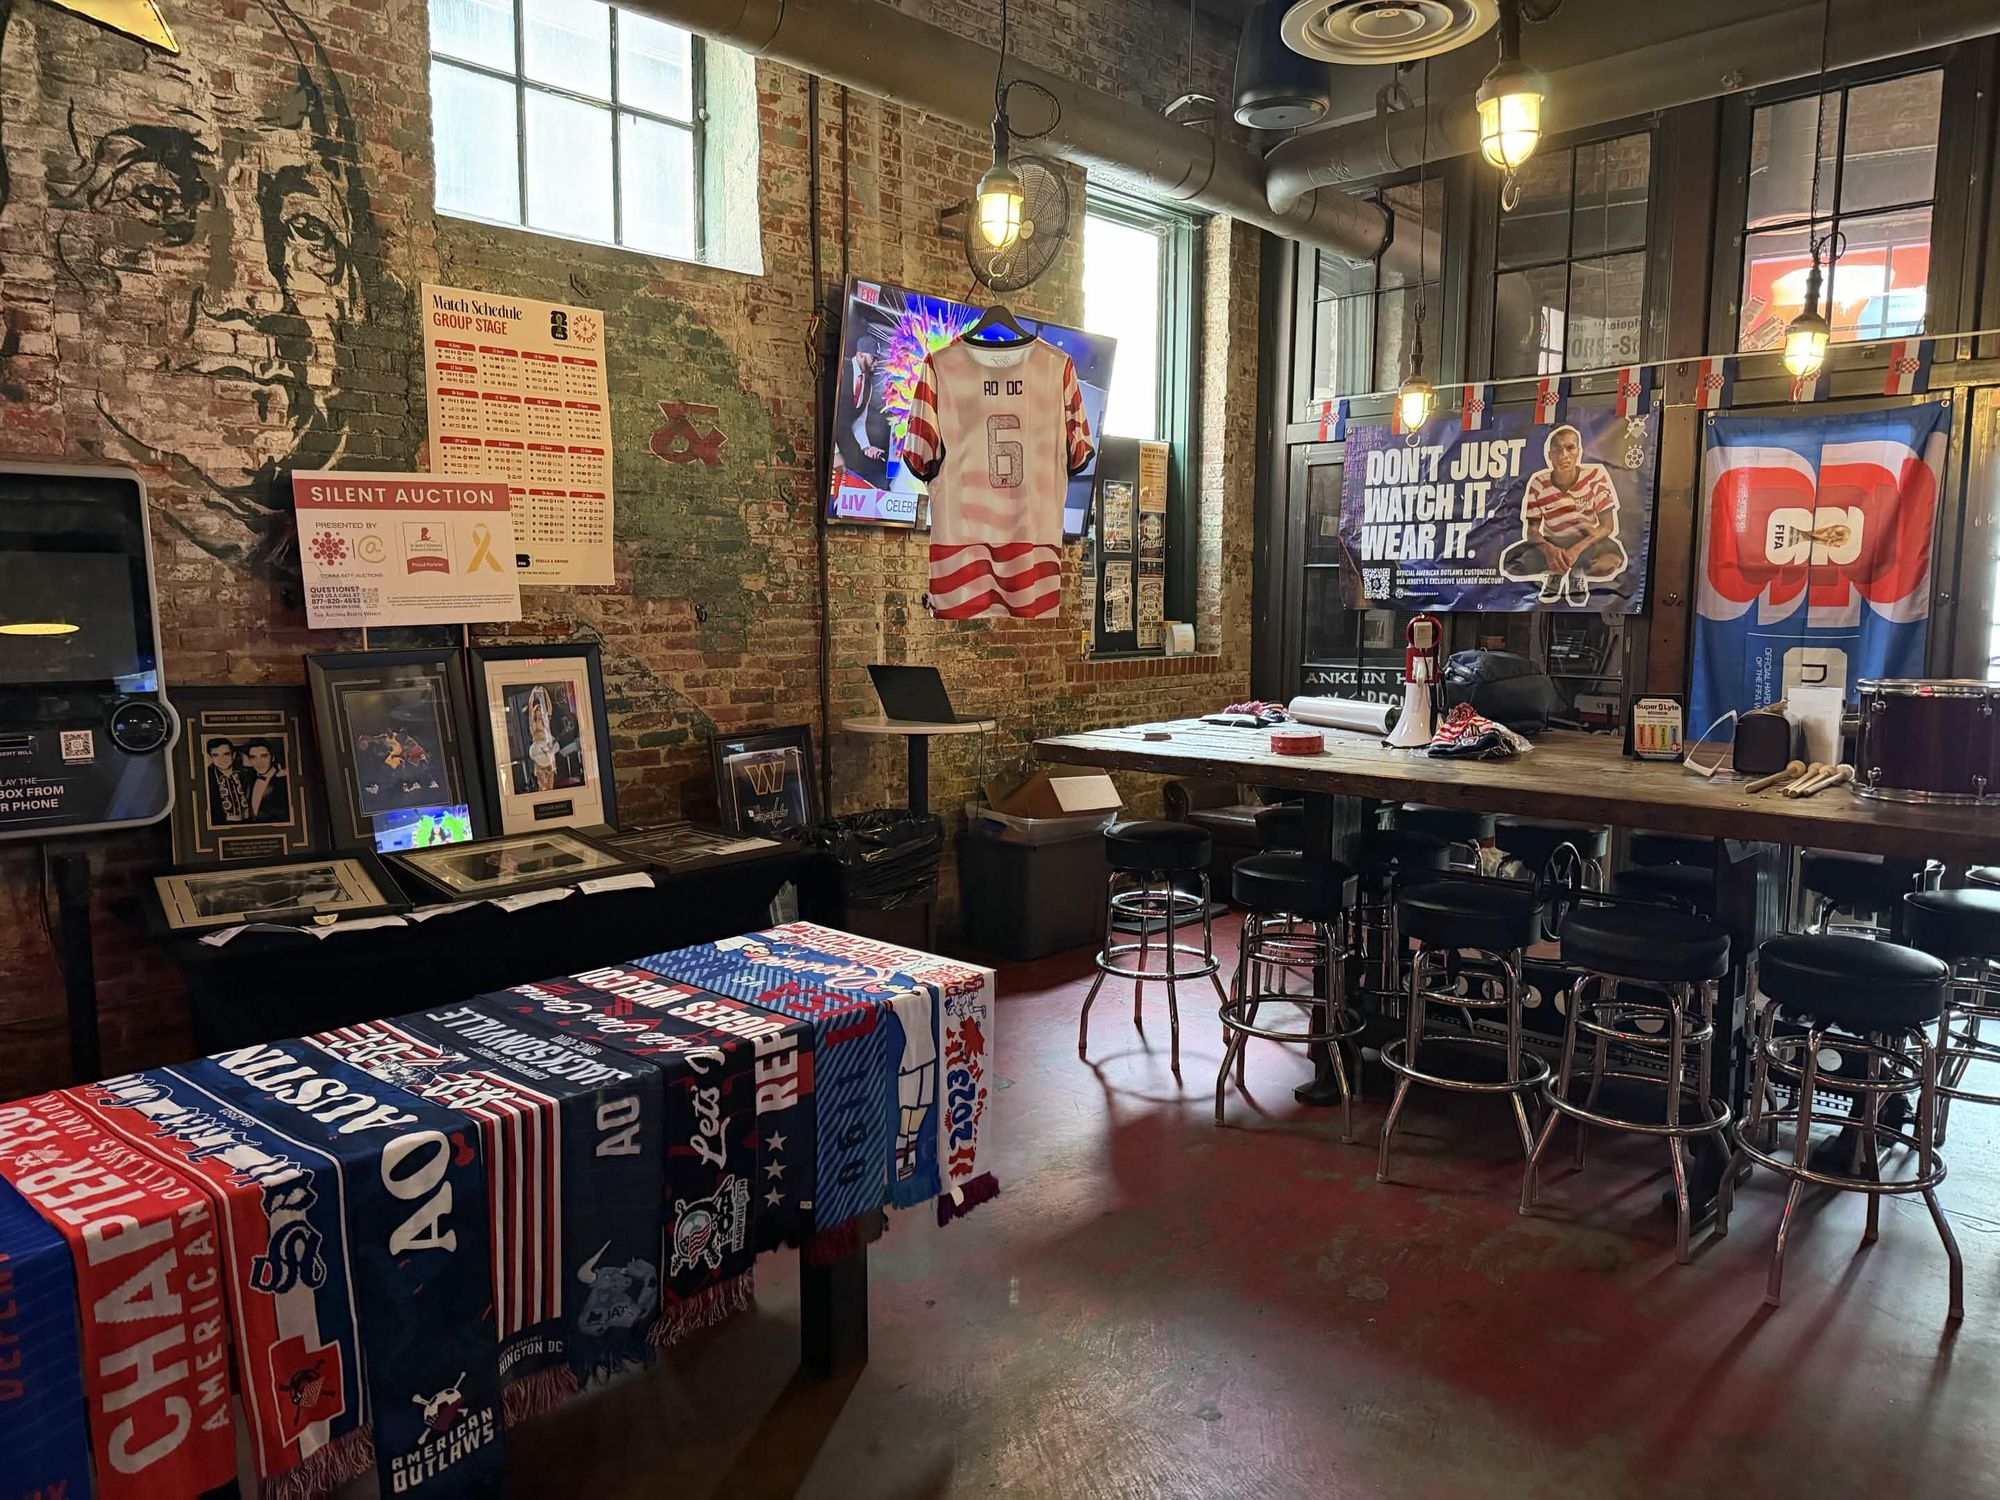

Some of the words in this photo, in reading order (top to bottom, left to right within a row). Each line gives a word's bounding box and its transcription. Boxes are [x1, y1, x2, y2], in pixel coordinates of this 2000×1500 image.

[432, 294, 469, 313] Match
[471, 300, 523, 320] Schedule
[433, 312, 472, 331] GROUP
[475, 319, 508, 335] STAGE
[573, 314, 597, 330] STELLA
[573, 329, 598, 344] ARTOIS
[987, 414, 1023, 488] 6
[1365, 445, 1444, 486] DON'T
[1450, 438, 1527, 481] JUST
[310, 486, 387, 502] SILENT
[395, 488, 495, 505] AUCTION
[1364, 484, 1456, 523] WATCH
[1462, 481, 1496, 520] IT.
[315, 521, 364, 529] PRESENTED
[1773, 523, 1785, 550] FIFA
[1361, 522, 1435, 561] WEAR
[1443, 522, 1477, 560] IT.
[310, 586, 360, 594] QUESTIONS?
[1755, 656, 1763, 667] OF
[1763, 647, 1773, 681] OFFICIAL
[1755, 668, 1763, 684] THE
[1754, 685, 1762, 700] FIFA
[1763, 681, 1772, 704] HARD
[1636, 703, 1657, 711] Super
[19, 777, 37, 785] THE
[27, 785, 65, 797] FROM
[12, 798, 59, 812] PHONE
[426, 1007, 633, 1086] JACKSONVILLE
[571, 1040, 602, 1056] SINCE
[206, 1043, 419, 1134] AUSTIN
[29, 1094, 100, 1140] LONDON
[946, 1068, 976, 1150] 2023
[596, 1096, 641, 1157] AO
[381, 1130, 457, 1257] AO
[16, 1157, 193, 1474] CHAPTER
[176, 1199, 230, 1431] AMERICAN
[547, 1340, 564, 1353] DC
[391, 1406, 494, 1471] AMERICAN
[392, 1421, 495, 1494] OUTLAWS
